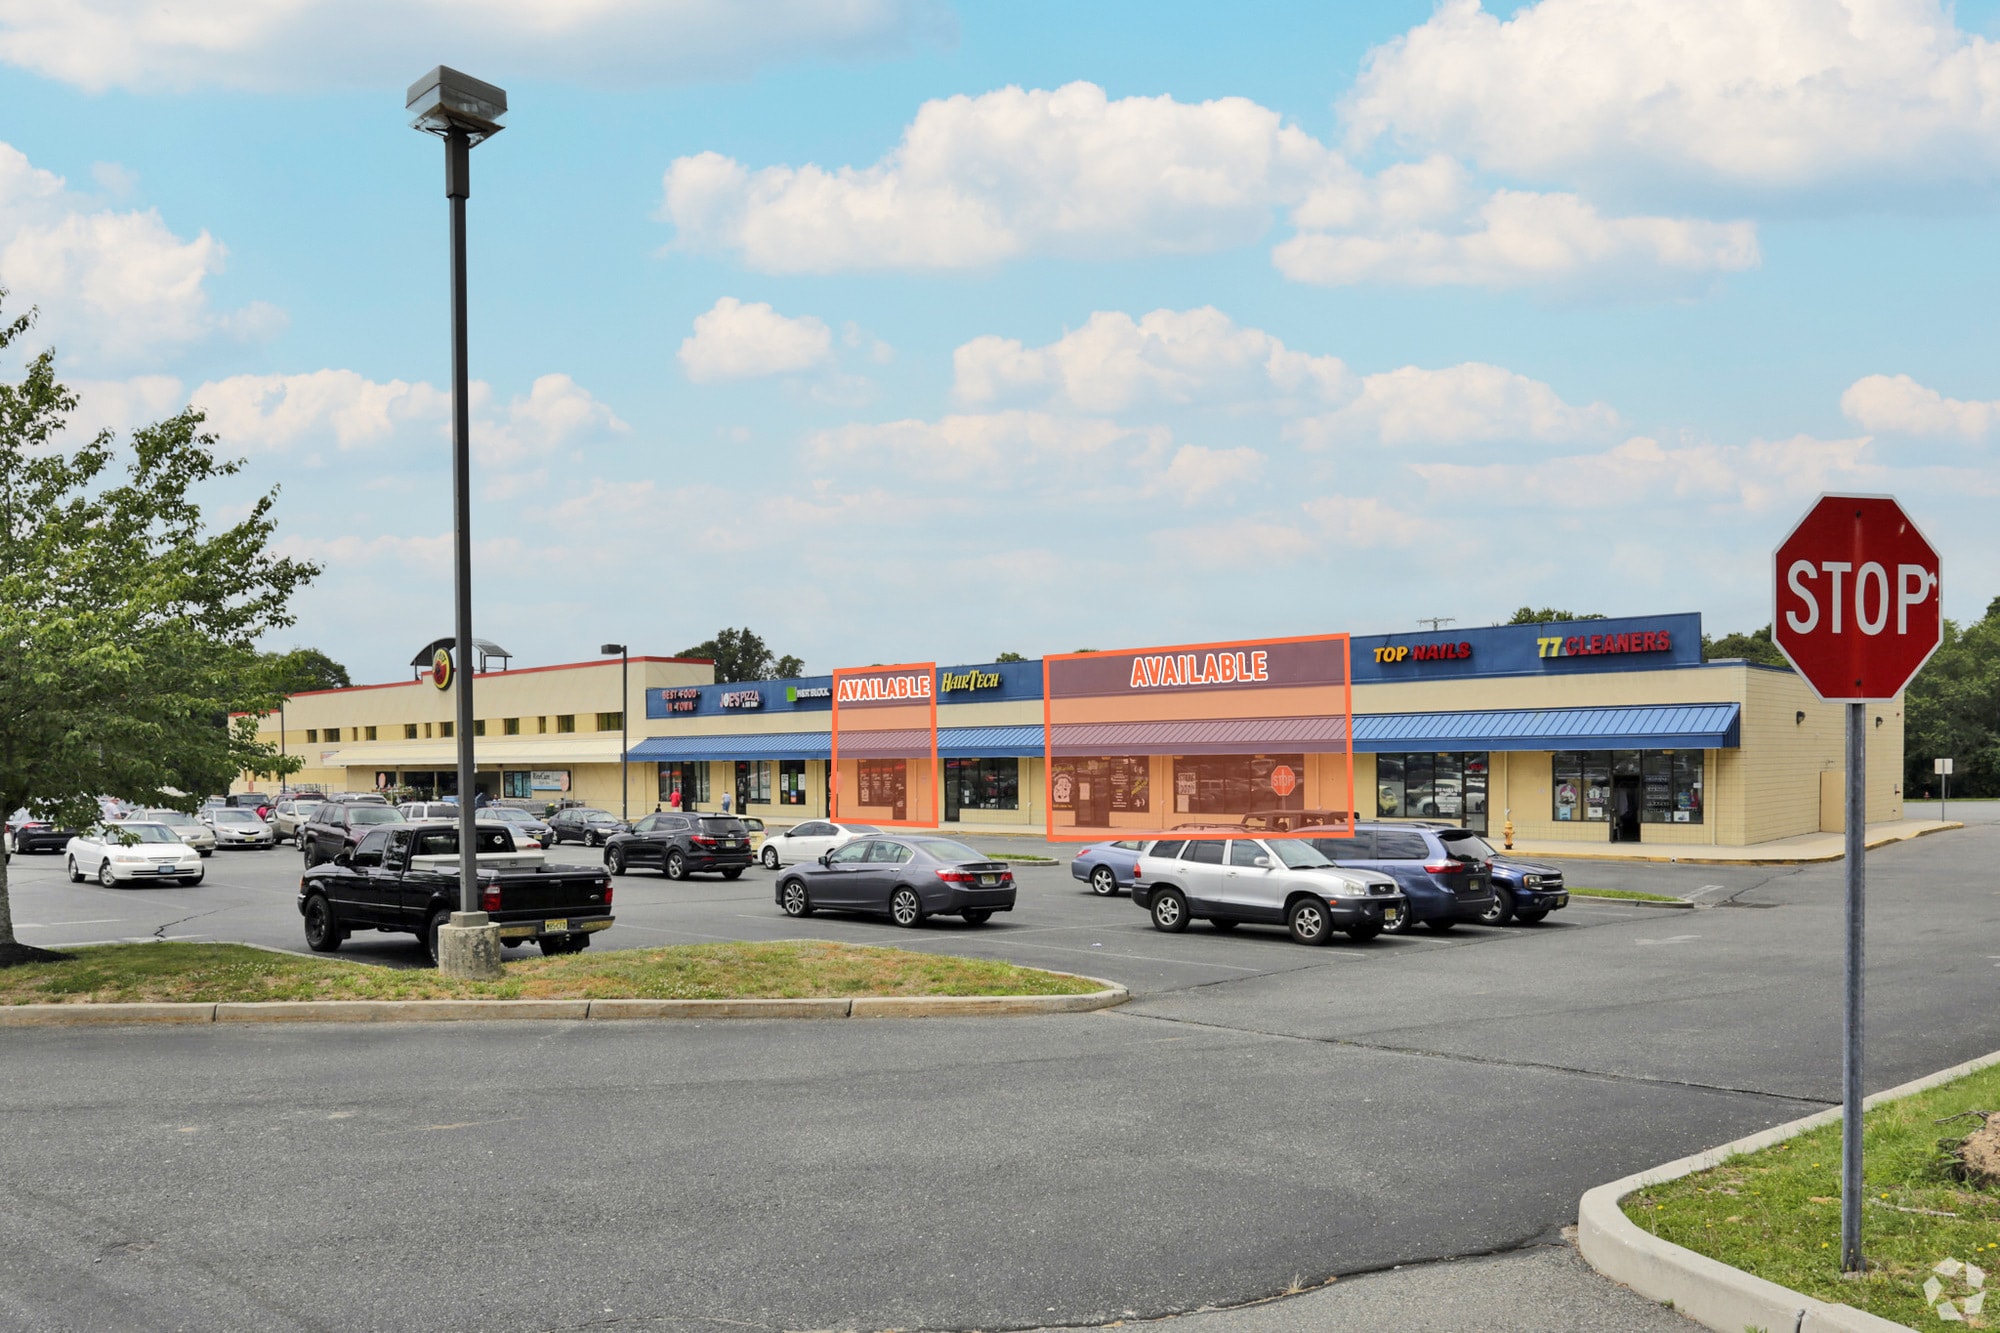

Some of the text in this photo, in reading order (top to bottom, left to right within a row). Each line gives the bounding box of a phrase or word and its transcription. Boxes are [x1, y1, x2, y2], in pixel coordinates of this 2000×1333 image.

[1786, 560, 1930, 636] STOP
[1537, 629, 1671, 657] 77 CLEANERS
[1373, 642, 1471, 663] TOP NAILS
[662, 688, 697, 700] BEST FOOD
[740, 690, 759, 702] PIZZA
[1273, 774, 1294, 787] STOP
